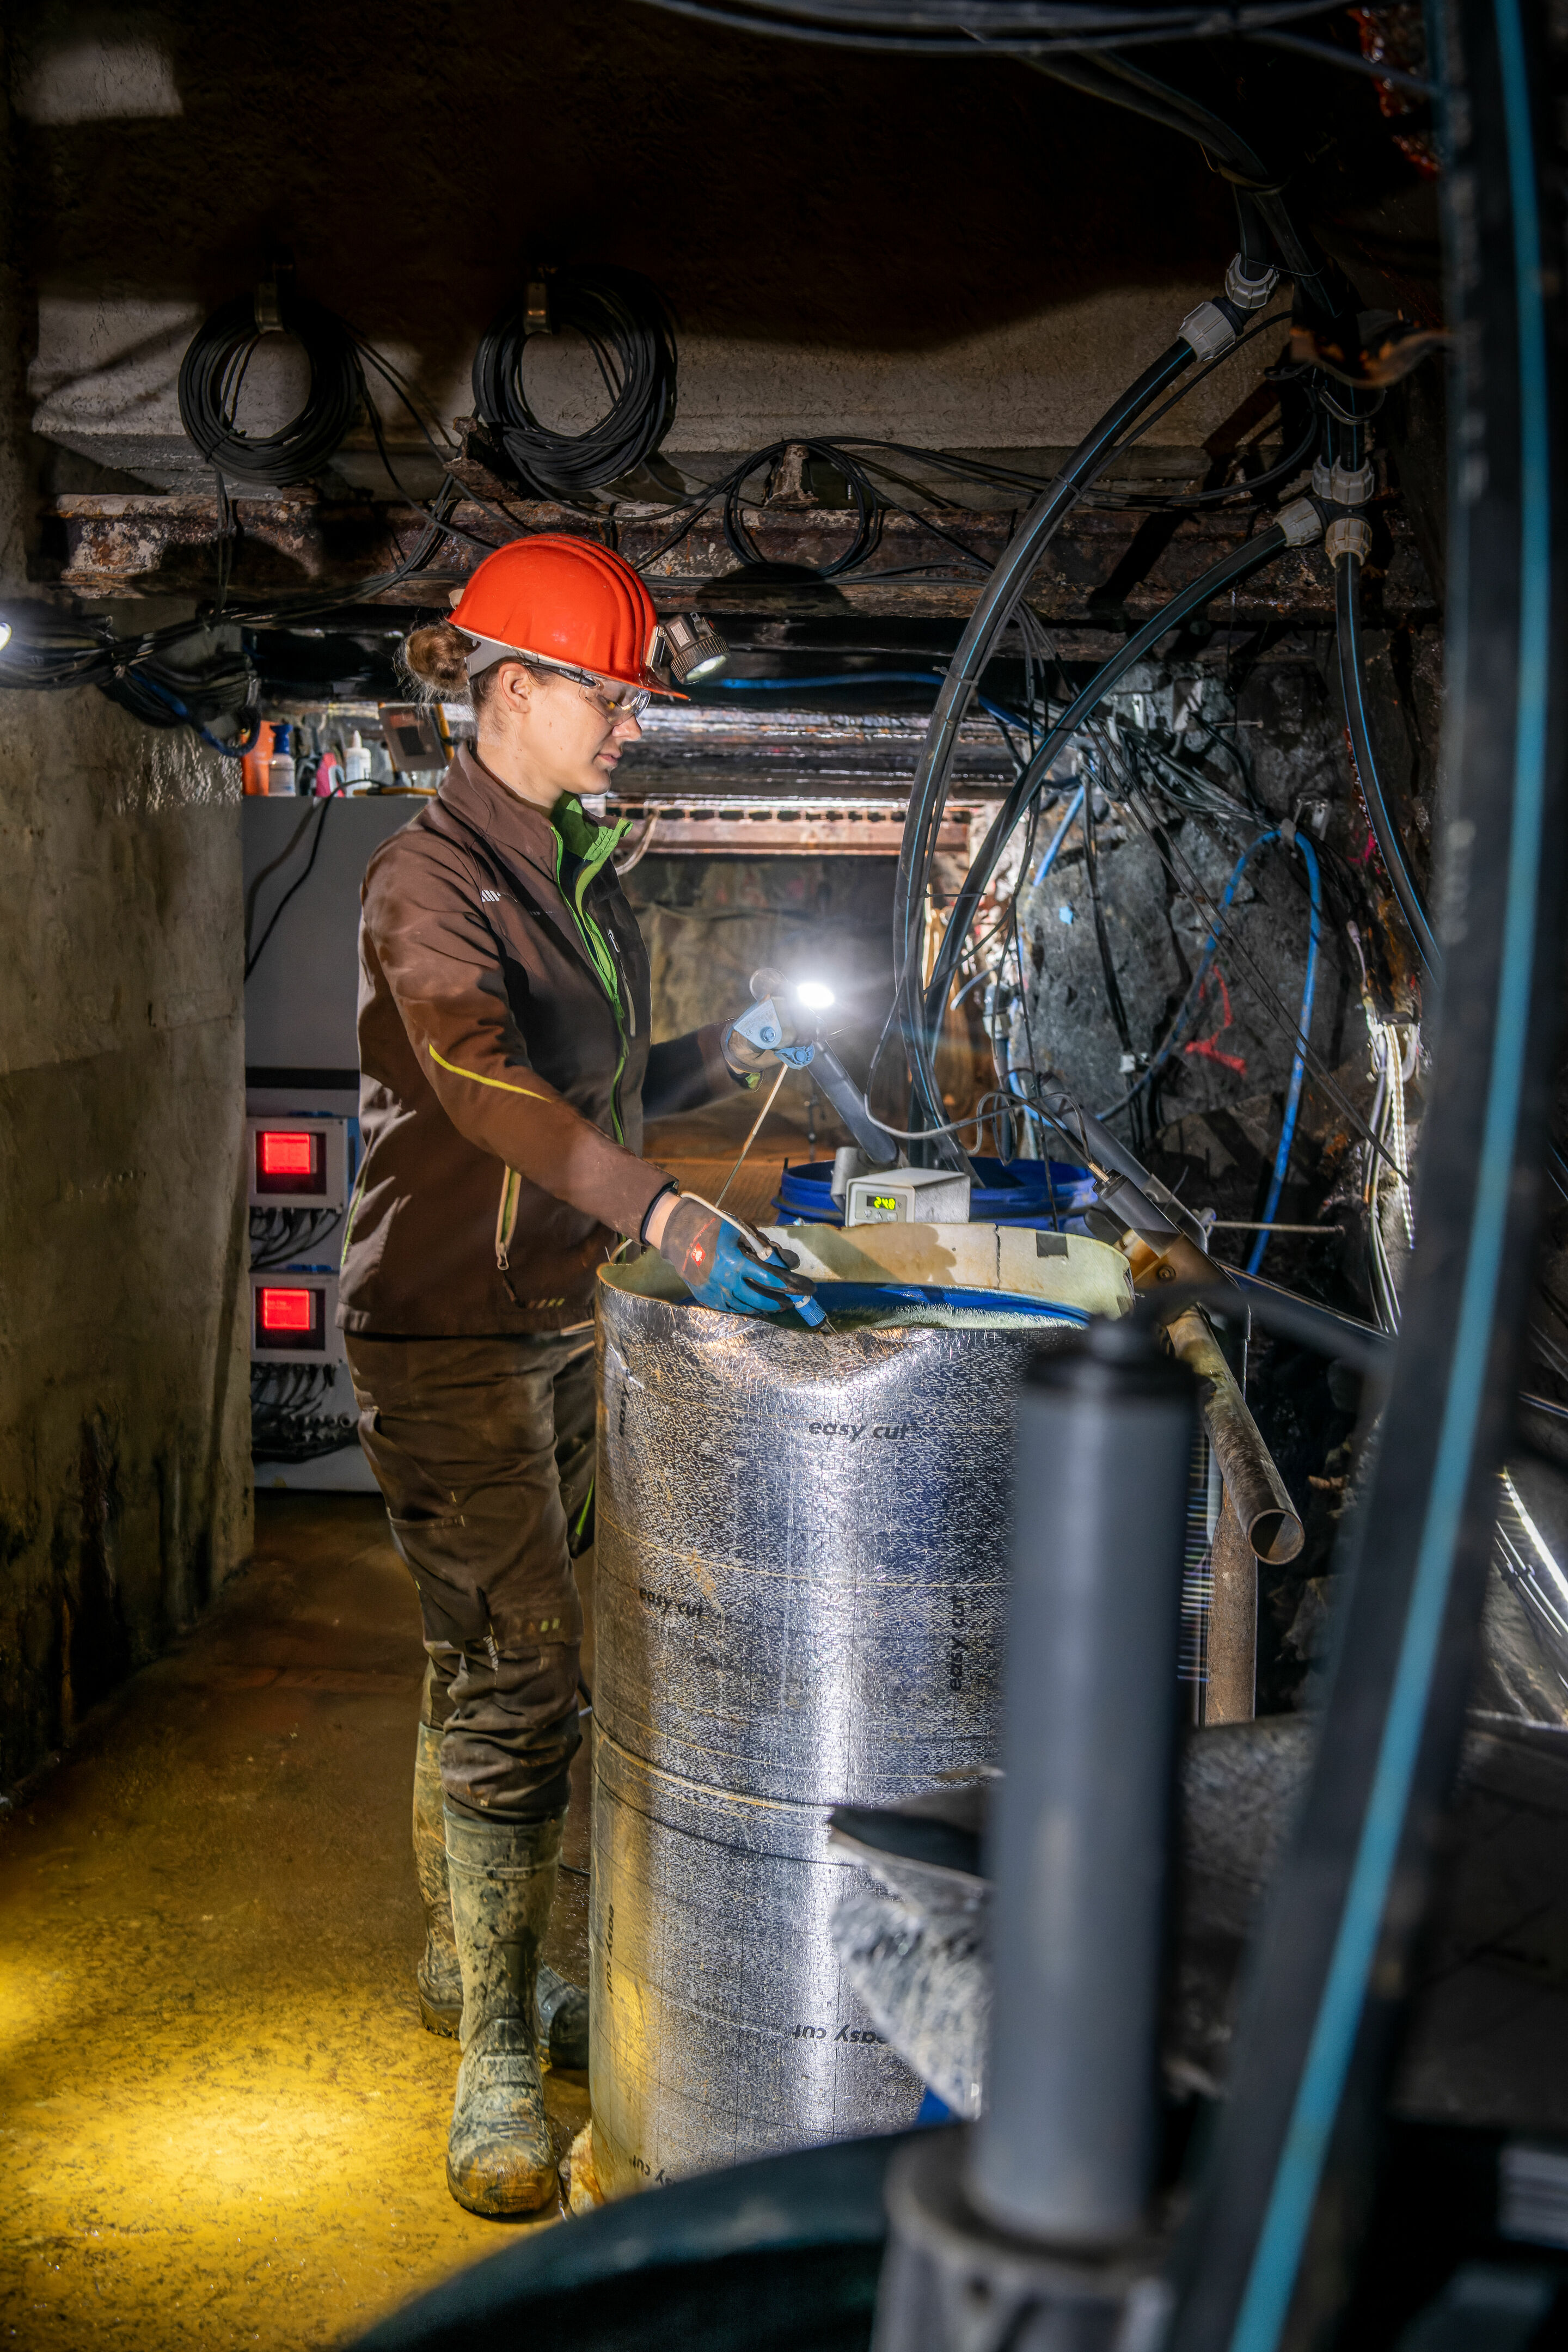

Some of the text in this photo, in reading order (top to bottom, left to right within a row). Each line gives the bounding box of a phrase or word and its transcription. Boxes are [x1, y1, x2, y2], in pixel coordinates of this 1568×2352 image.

[808, 1422, 868, 1443] easy
[639, 1588, 673, 1614] easy
[952, 1635, 969, 1690] easy
[605, 1903, 614, 1959] easy
